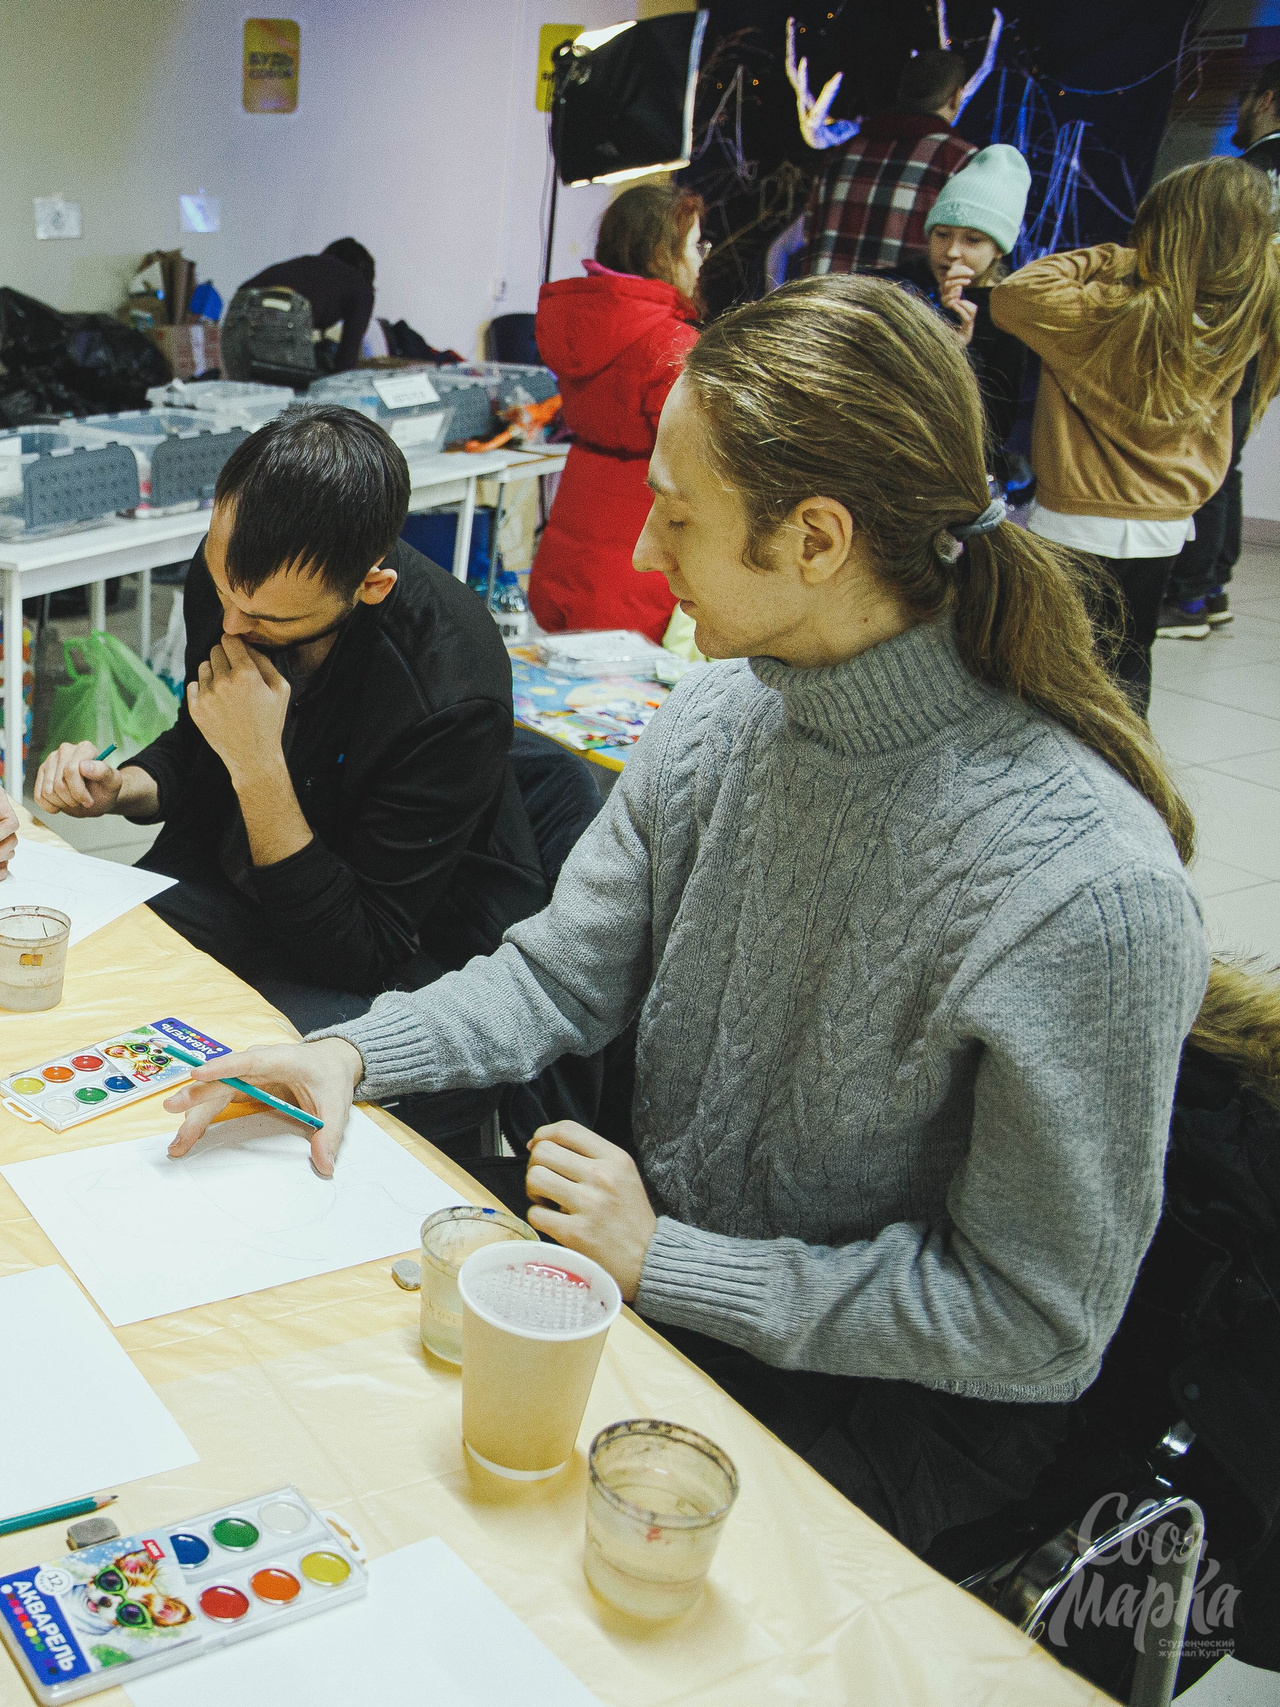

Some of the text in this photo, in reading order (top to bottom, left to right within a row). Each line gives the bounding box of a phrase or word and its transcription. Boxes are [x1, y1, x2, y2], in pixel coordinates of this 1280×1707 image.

[161, 1023, 218, 1056] АКВАРЕЛЬ
[47, 1574, 63, 1588] 12
[12, 1580, 78, 1672] АКВАРЕЛЬ
